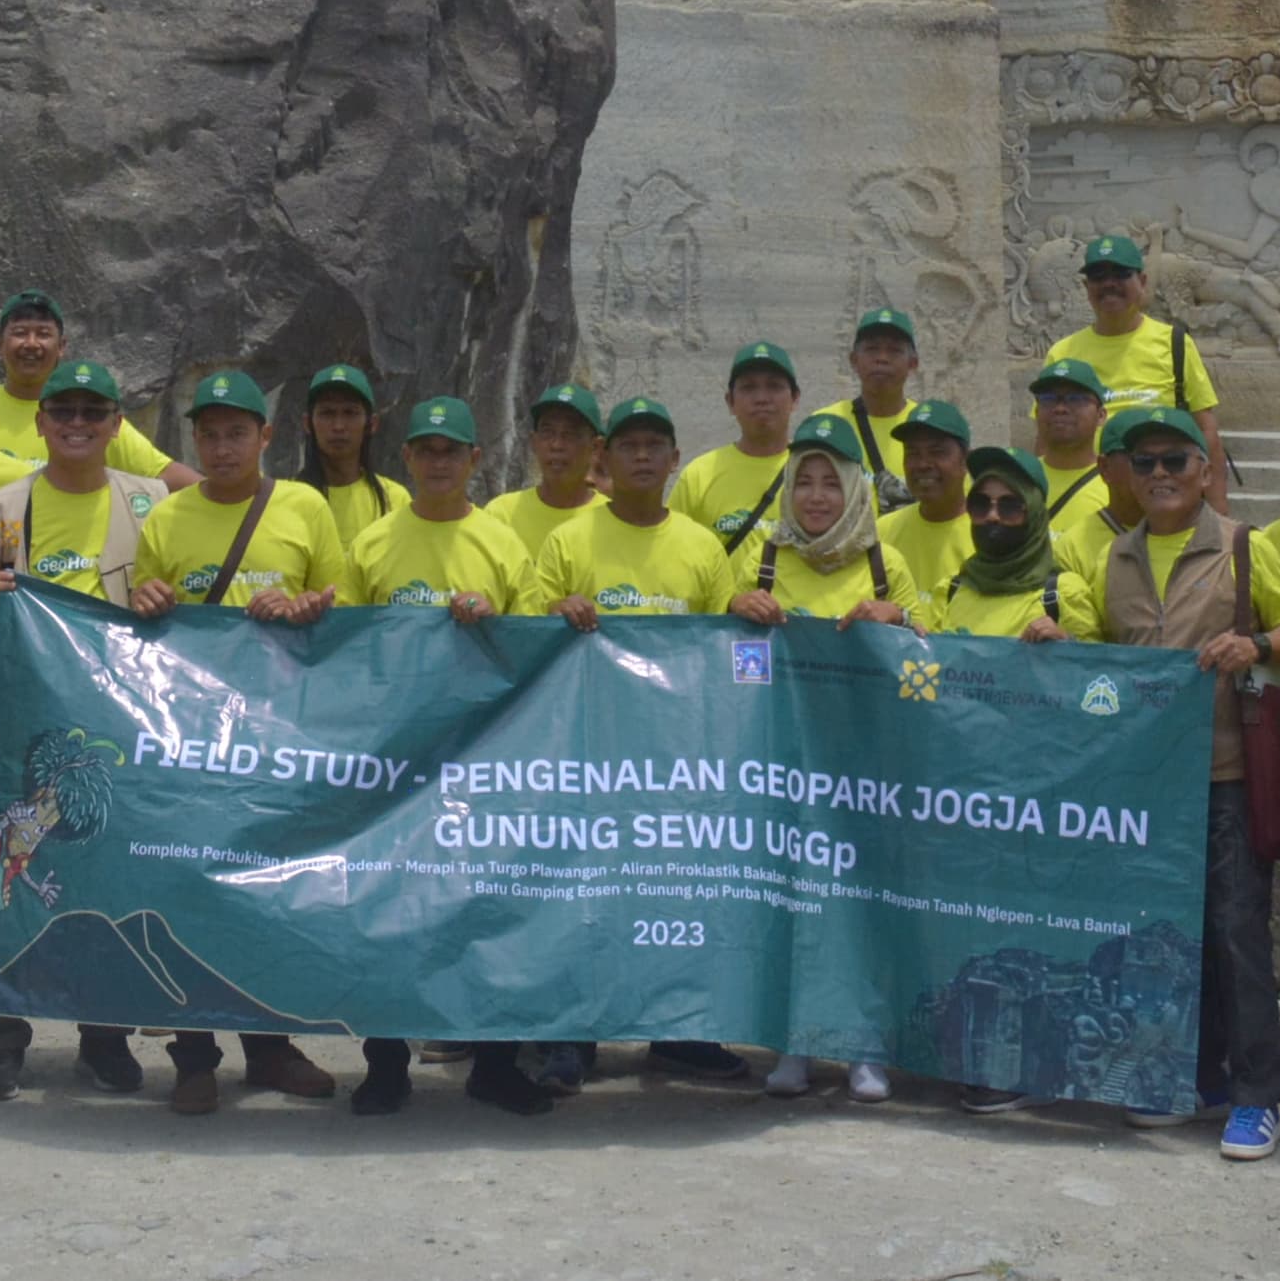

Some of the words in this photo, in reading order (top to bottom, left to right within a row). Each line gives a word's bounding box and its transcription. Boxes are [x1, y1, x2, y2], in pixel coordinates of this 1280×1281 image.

[944, 668, 995, 686] DANA
[133, 731, 259, 775] FIELD
[270, 746, 410, 792] STUDY
[439, 758, 726, 795] PENGENALAN
[738, 760, 904, 818] GEOPARK
[911, 786, 1045, 835] JOGJA
[1057, 801, 1149, 846] DAN
[434, 814, 619, 851] GUNUNG
[632, 814, 755, 851] SEWU
[765, 820, 857, 877] UGGp
[129, 841, 198, 859] Kompleks
[201, 846, 280, 869] Perbukitan
[334, 858, 392, 872] Godean
[405, 859, 455, 875] Merapi
[458, 861, 485, 874] Tua
[487, 860, 528, 877] Turgo
[531, 863, 607, 881] Plawangan
[620, 862, 662, 876] Aliran
[666, 862, 741, 879] Piroklastik
[831, 882, 872, 900] Breksi
[882, 888, 930, 911] Rayapan
[933, 898, 973, 917] Tanah
[976, 905, 1034, 926] Nglepen
[1047, 914, 1081, 931] Lava
[1084, 917, 1131, 936] Bantal
[475, 880, 508, 895] Batu
[511, 884, 574, 901] Gamping
[577, 884, 620, 898] Eosen
[637, 882, 692, 900] Gunung
[695, 885, 718, 901] Api
[722, 884, 761, 901] Purba
[632, 919, 705, 947] 2023
